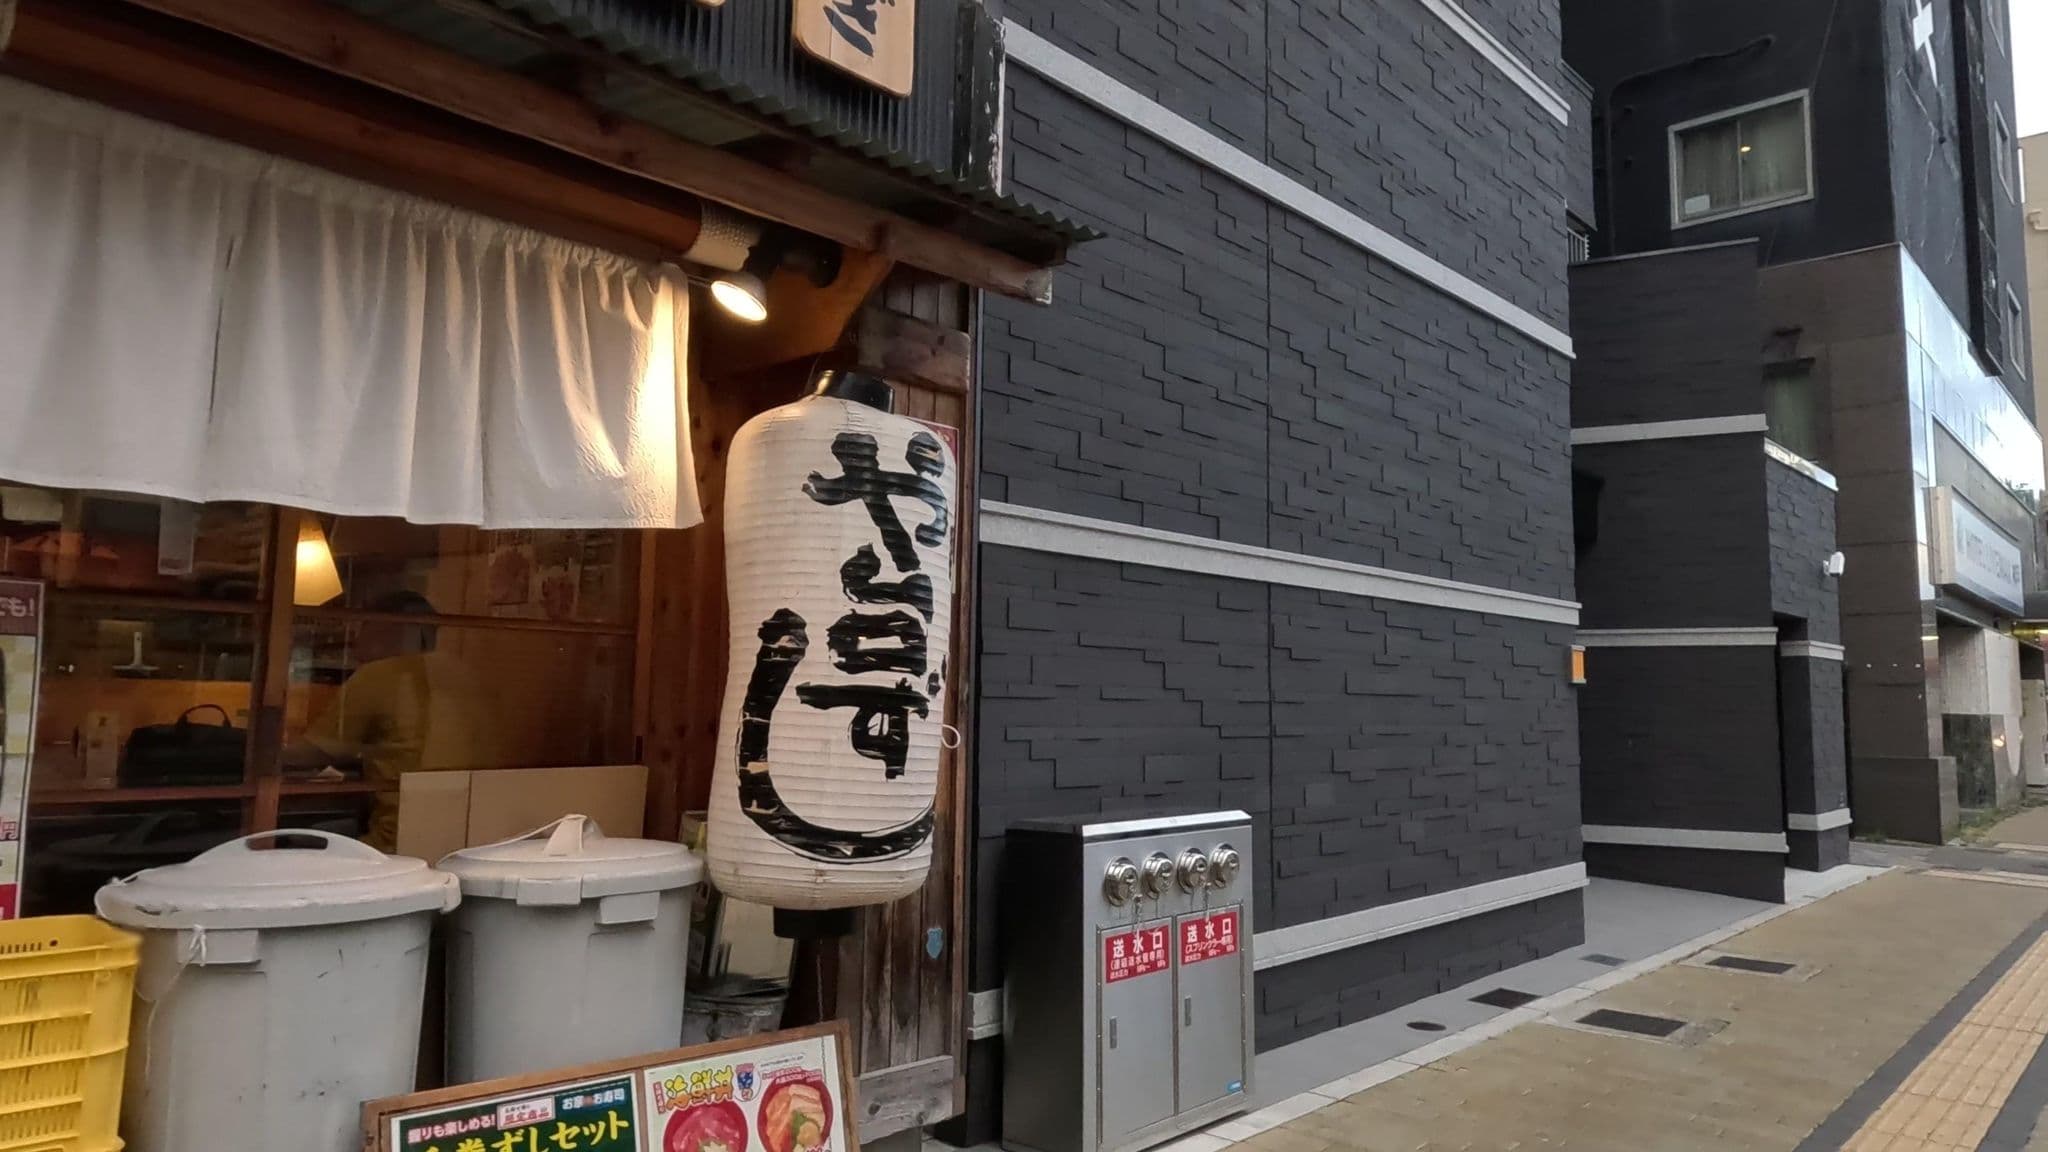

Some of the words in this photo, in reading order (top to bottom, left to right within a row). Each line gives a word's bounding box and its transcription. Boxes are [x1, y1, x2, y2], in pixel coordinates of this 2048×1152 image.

[1187, 918, 1232, 943] 送水口
[1113, 931, 1163, 959] 送水口
